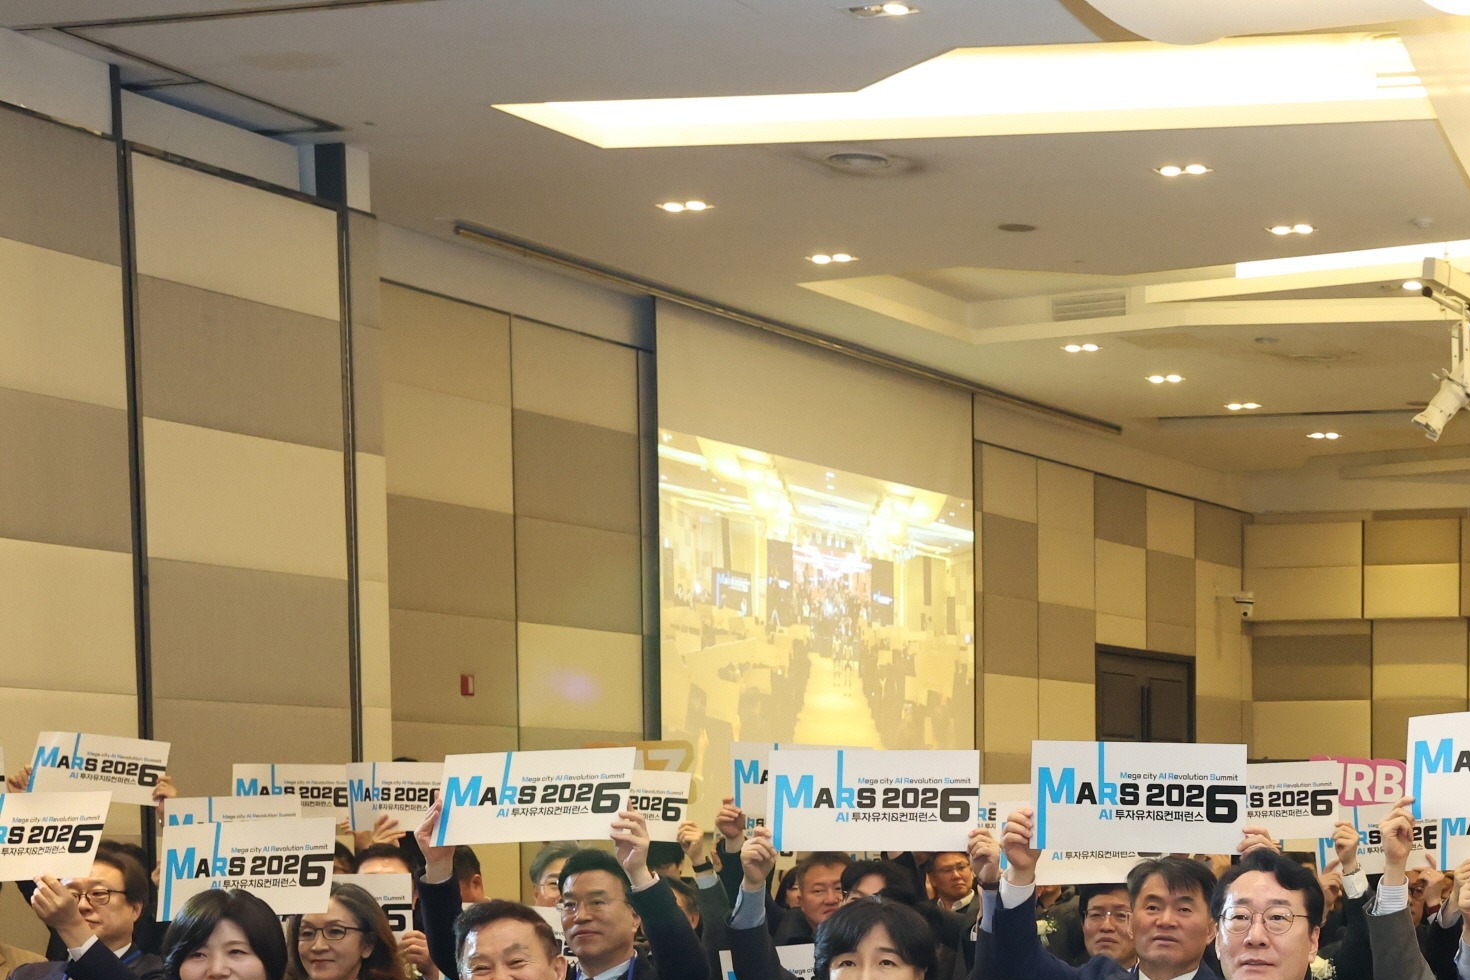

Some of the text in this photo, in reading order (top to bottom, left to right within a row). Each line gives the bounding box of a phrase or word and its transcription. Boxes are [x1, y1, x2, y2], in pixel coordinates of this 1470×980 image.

[101, 760, 166, 787] 2026
[541, 775, 554, 783] city
[858, 777, 879, 786] Mega
[879, 777, 894, 786] city
[1120, 771, 1238, 782] Mega city AI Revolution Summit
[350, 779, 391, 802] MARS
[446, 776, 631, 814] MARS 2026
[775, 774, 979, 823] MARS 2026
[1037, 767, 1246, 824] MARS 2026
[496, 808, 509, 818] AI
[629, 796, 689, 822] 2026
[1268, 789, 1339, 817] 2026
[30, 816, 41, 824] city
[836, 812, 849, 822] AI
[1098, 808, 1204, 823] AI 투자유치&컨퍼런스
[28, 823, 104, 854] 2026
[250, 846, 262, 854] city
[271, 844, 304, 852] Revolution
[164, 847, 335, 887] MARS 2026
